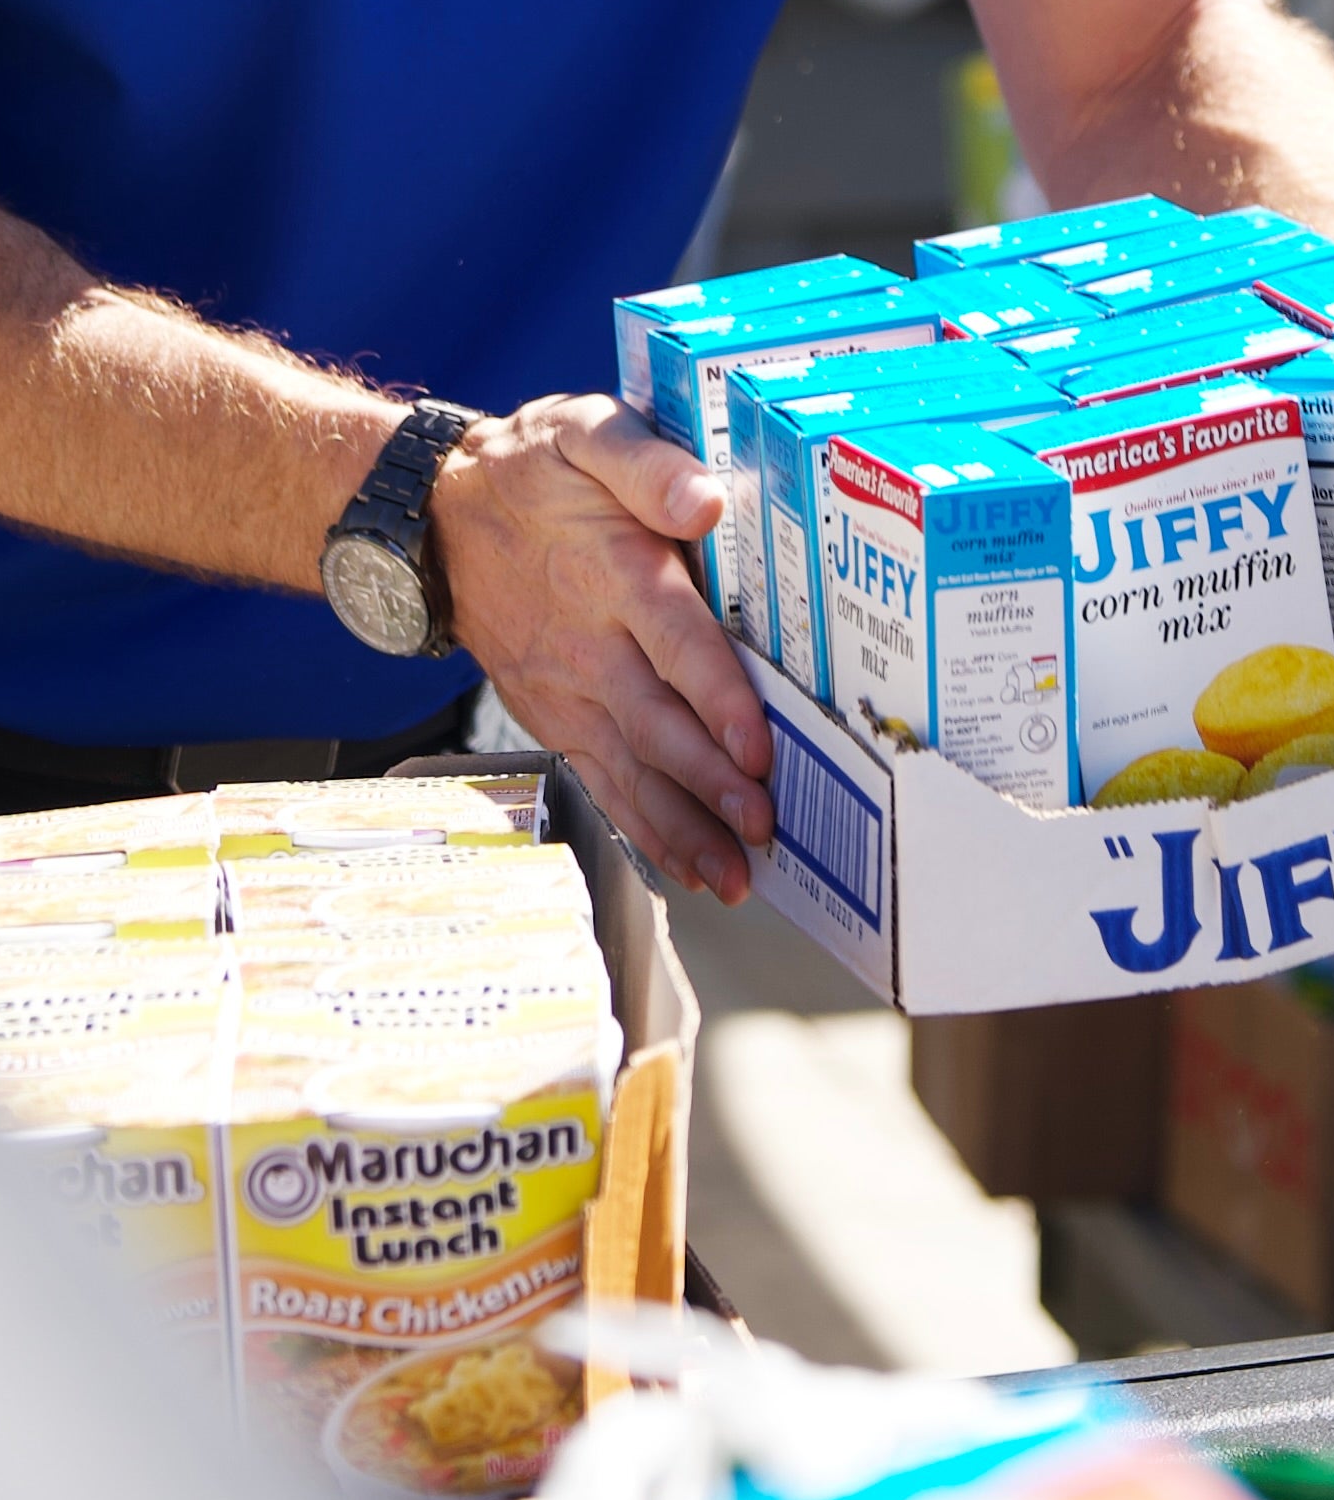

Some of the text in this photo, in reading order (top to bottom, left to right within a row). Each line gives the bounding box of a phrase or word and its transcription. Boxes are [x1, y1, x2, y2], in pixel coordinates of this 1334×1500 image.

[1047, 407, 1289, 482] America's Favorite
[829, 443, 875, 495] America's
[876, 466, 919, 519] Favorite
[1124, 468, 1276, 517] Quality and Value since 1930
[951, 528, 1045, 552] corn muffin
[983, 550, 1015, 566] mix
[980, 589, 1019, 605] corn
[1082, 549, 1296, 625] corn muffin
[837, 592, 915, 662] corn muffin
[967, 604, 1034, 625] muffins
[1158, 602, 1232, 644] mix
[860, 641, 889, 682] mix
[1092, 703, 1170, 730] add egg and milk
[306, 1121, 578, 1185] Maruchan
[330, 1180, 515, 1231] Instant
[355, 1222, 499, 1264] Lunch
[249, 1278, 365, 1328] Roast
[371, 1271, 533, 1337] Chicken
